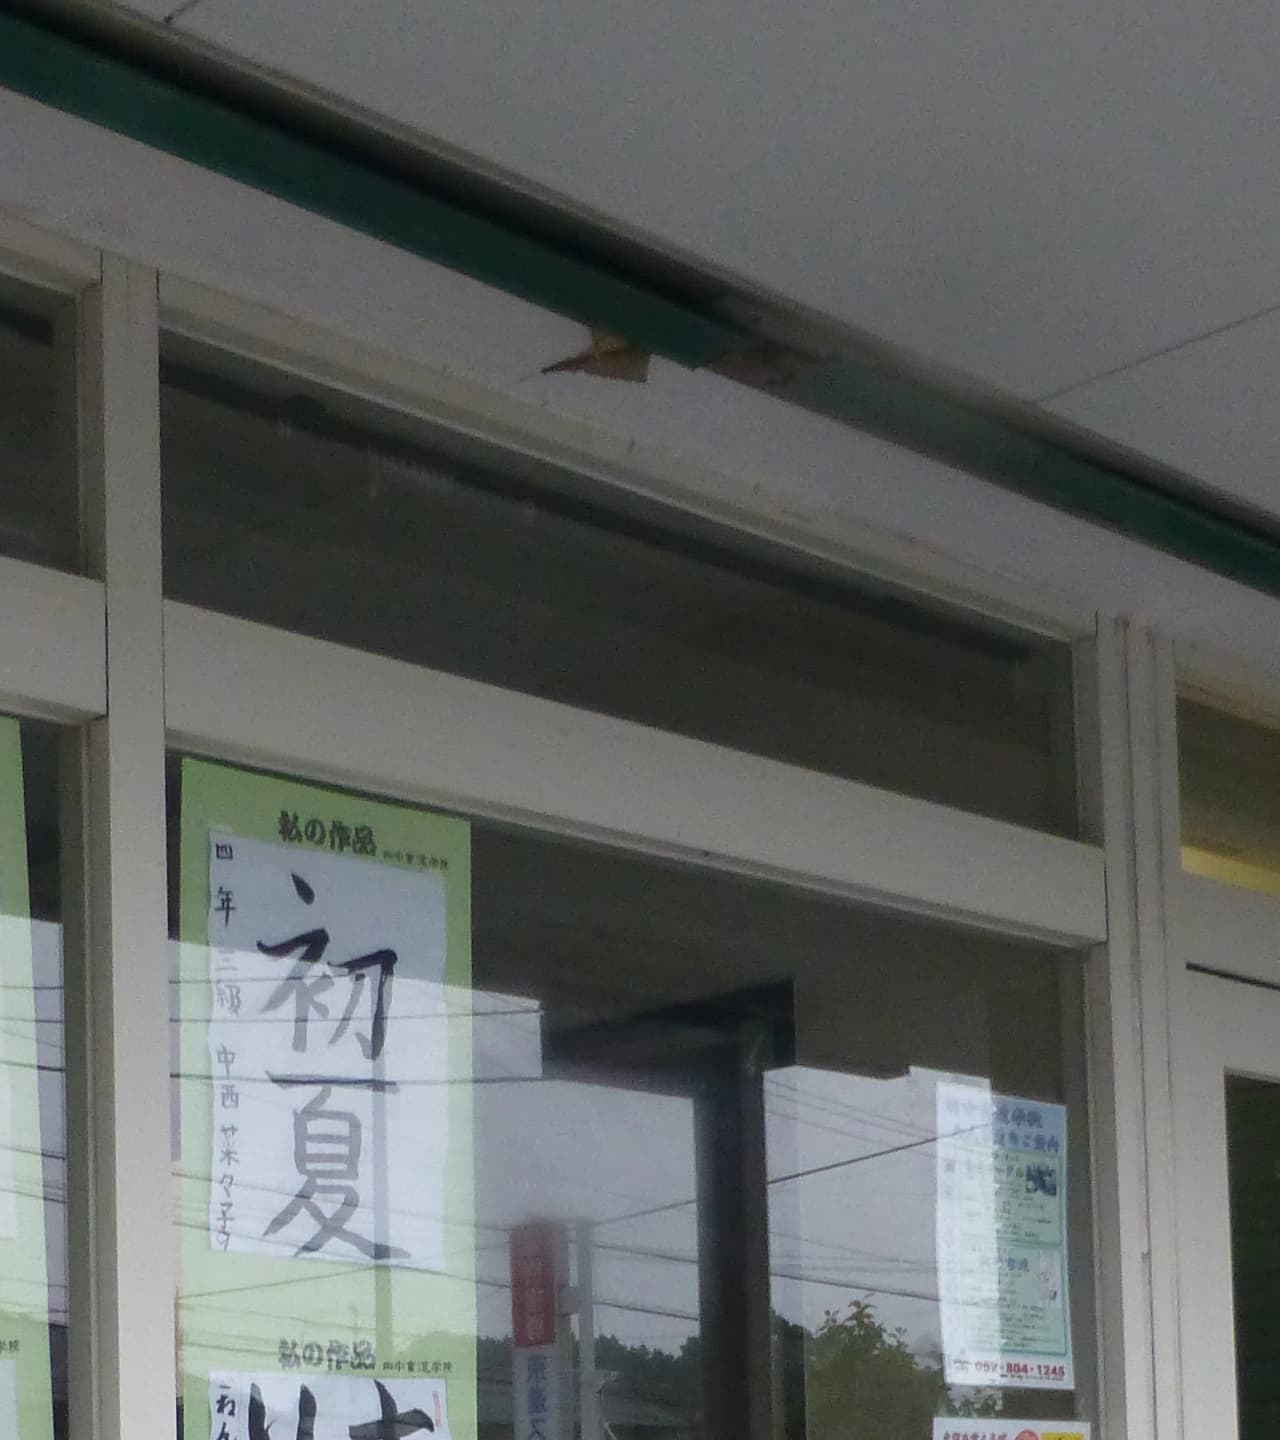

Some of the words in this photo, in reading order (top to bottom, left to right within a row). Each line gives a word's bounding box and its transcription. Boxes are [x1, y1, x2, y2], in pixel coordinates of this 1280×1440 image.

[278, 809, 377, 856] 私の作品
[215, 843, 237, 930] 四年
[256, 871, 412, 1261] 初夏
[278, 1339, 377, 1371] 私の作品
